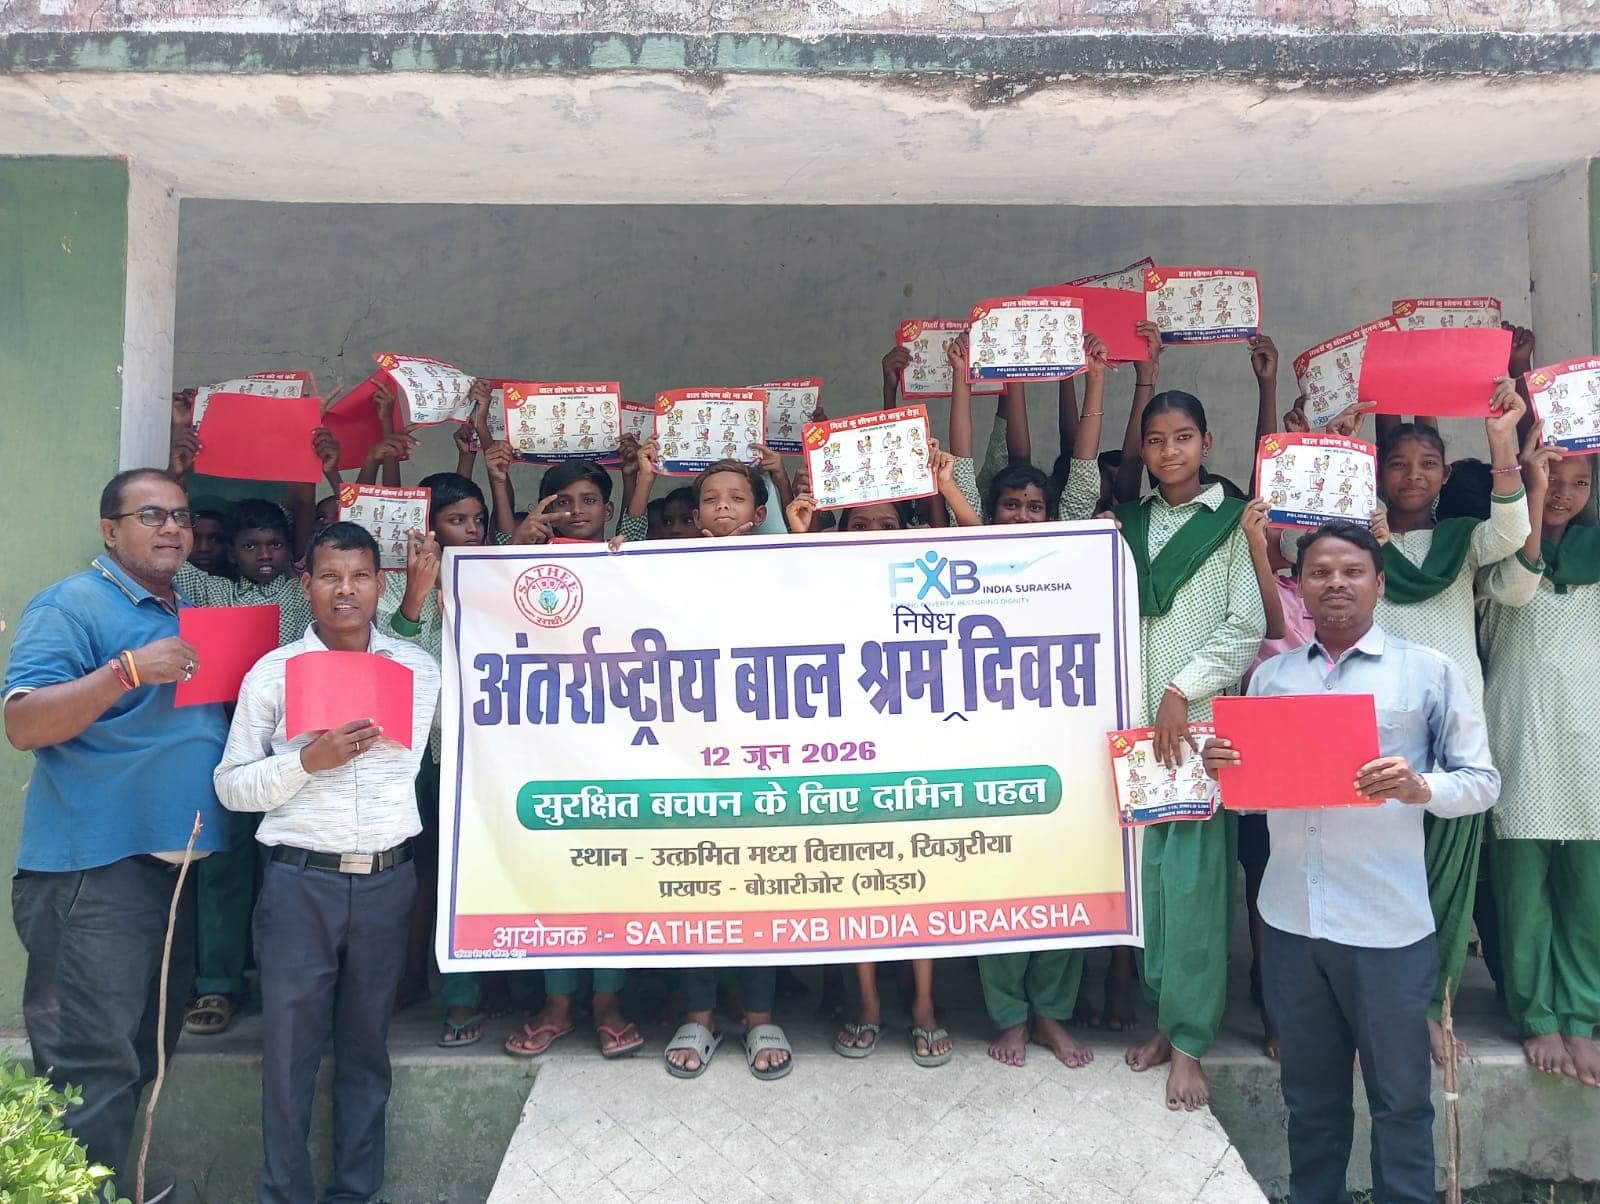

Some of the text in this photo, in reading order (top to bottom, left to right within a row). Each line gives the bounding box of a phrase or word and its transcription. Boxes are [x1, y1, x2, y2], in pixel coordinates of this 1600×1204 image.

[518, 567, 579, 594] SATHEE
[888, 550, 981, 600] FXB
[982, 582, 1072, 594] INDIA SURAKSHA
[893, 604, 956, 634] निषेध
[473, 614, 1101, 745] अंतर्राष्ट्रीय बाल श्रम दिवस
[700, 741, 876, 771] 12 जून 2026
[532, 777, 1046, 826] सुरक्षित बचपन के लिए दामिन पहल
[569, 846, 628, 868] स्थान
[651, 840, 741, 867] उत्क्रमित
[748, 845, 797, 864] मध्य
[804, 837, 904, 864] विद्यालय,
[910, 830, 1013, 863] खिजुरीया
[658, 879, 721, 898] प्रखण्ड
[744, 870, 844, 896] बोआरीजोर
[851, 868, 927, 895] (गोड्डा)
[492, 919, 588, 948] आयोजक
[625, 919, 744, 945] SATHEE
[771, 917, 829, 943] FXB
[839, 913, 919, 941] INDIA
[927, 902, 1091, 935] SURAKSHA
